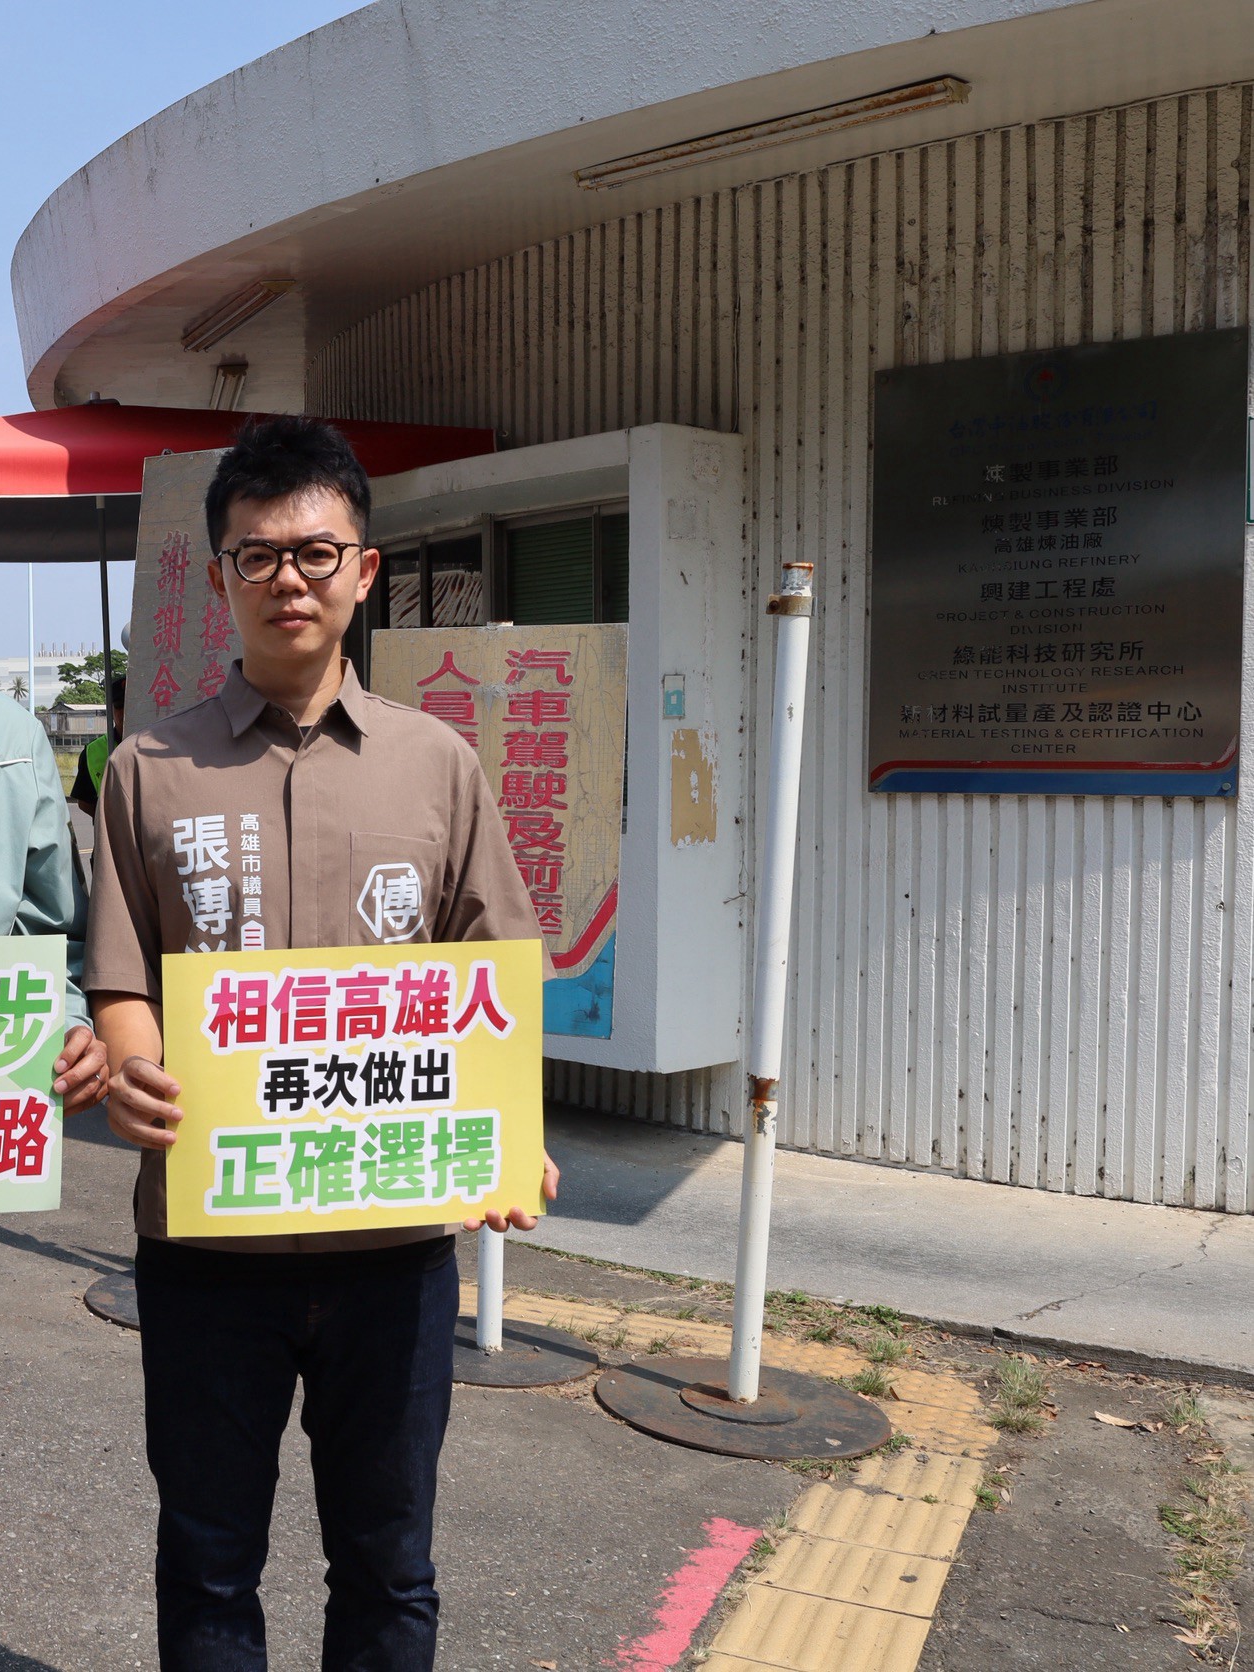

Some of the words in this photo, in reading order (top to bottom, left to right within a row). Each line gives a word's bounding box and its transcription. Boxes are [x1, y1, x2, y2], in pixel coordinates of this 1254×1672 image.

[983, 455, 1119, 483] 煉製事業部
[1010, 485, 1092, 500] BUSINESS
[1098, 479, 1174, 494] DIVISION
[982, 506, 1118, 534] 煉製事業部
[994, 532, 1103, 555] 高雄煉油廠
[1059, 553, 1140, 569] REFINERY
[981, 576, 1116, 602] 興建工程處
[1014, 609, 1025, 620] &
[1029, 604, 1165, 619] CONSTRUCTION
[1010, 623, 1082, 635] DIVISION
[953, 640, 1144, 666] 綠能科技研究所
[974, 667, 1086, 680] TECHNOLOGY
[1091, 665, 1184, 677] RESEARCH
[1003, 682, 1087, 694] INSTITUTE
[900, 700, 1202, 724] 新材料試量產及認證中心
[981, 728, 1049, 739] TESTING
[1054, 728, 1065, 739] &
[1070, 727, 1204, 739] CERTIFICATION
[1010, 743, 1077, 754] CENTER
[240, 813, 262, 917] 高雄市議員
[208, 966, 509, 1048] 相信高雄人
[263, 1049, 451, 1113] 再次做出
[211, 1116, 496, 1210] 正確選擇
